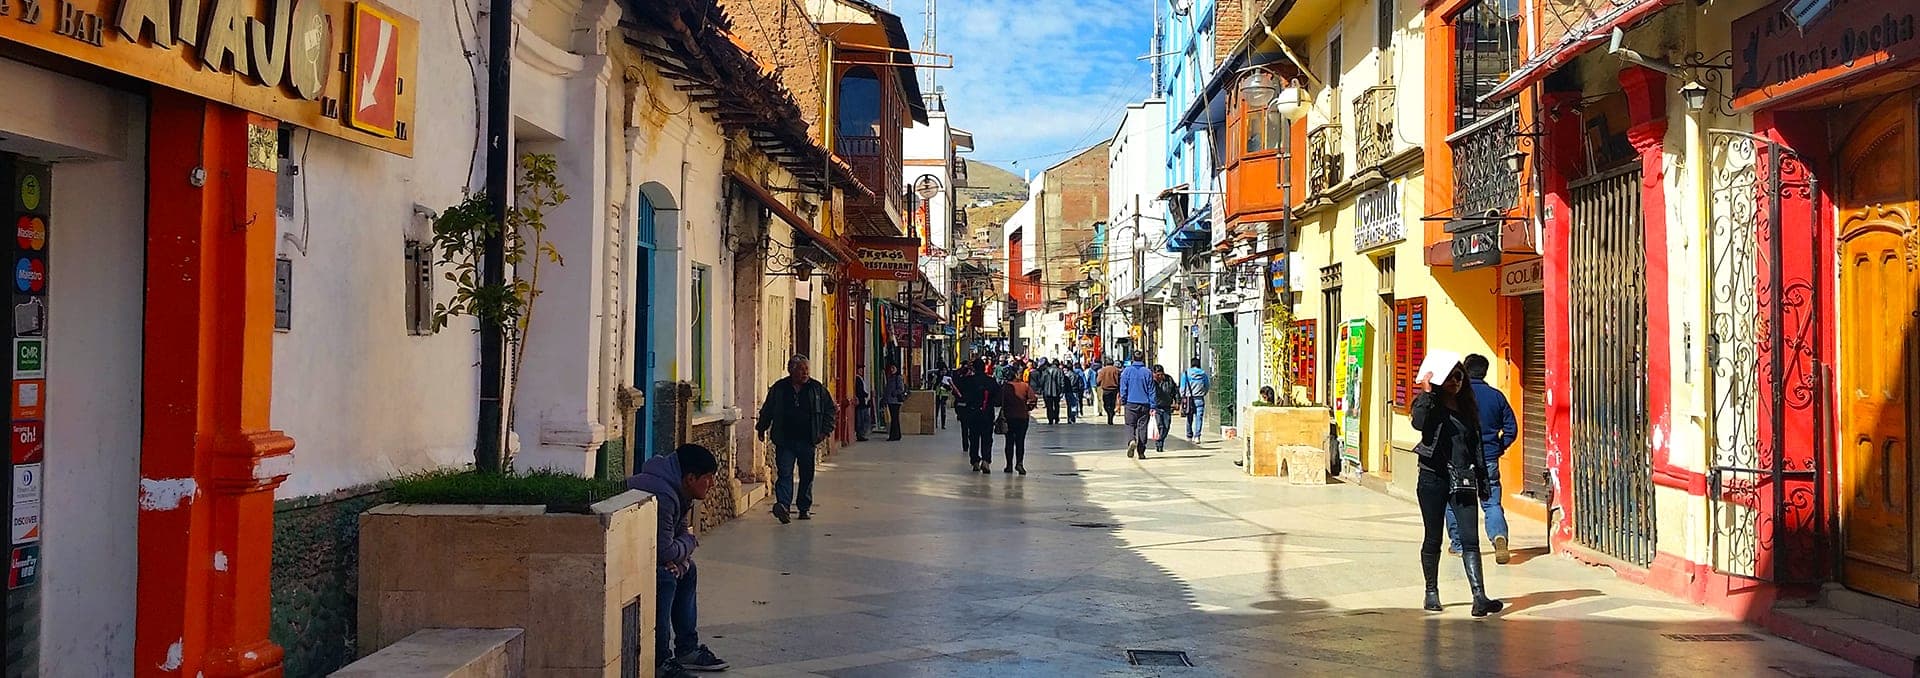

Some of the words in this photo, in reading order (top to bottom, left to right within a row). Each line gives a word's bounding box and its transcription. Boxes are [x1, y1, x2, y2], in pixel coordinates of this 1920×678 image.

[56, 0, 104, 47] BAR
[864, 261, 913, 270] RESTAURANT
[14, 515, 38, 527] DISCOVER
